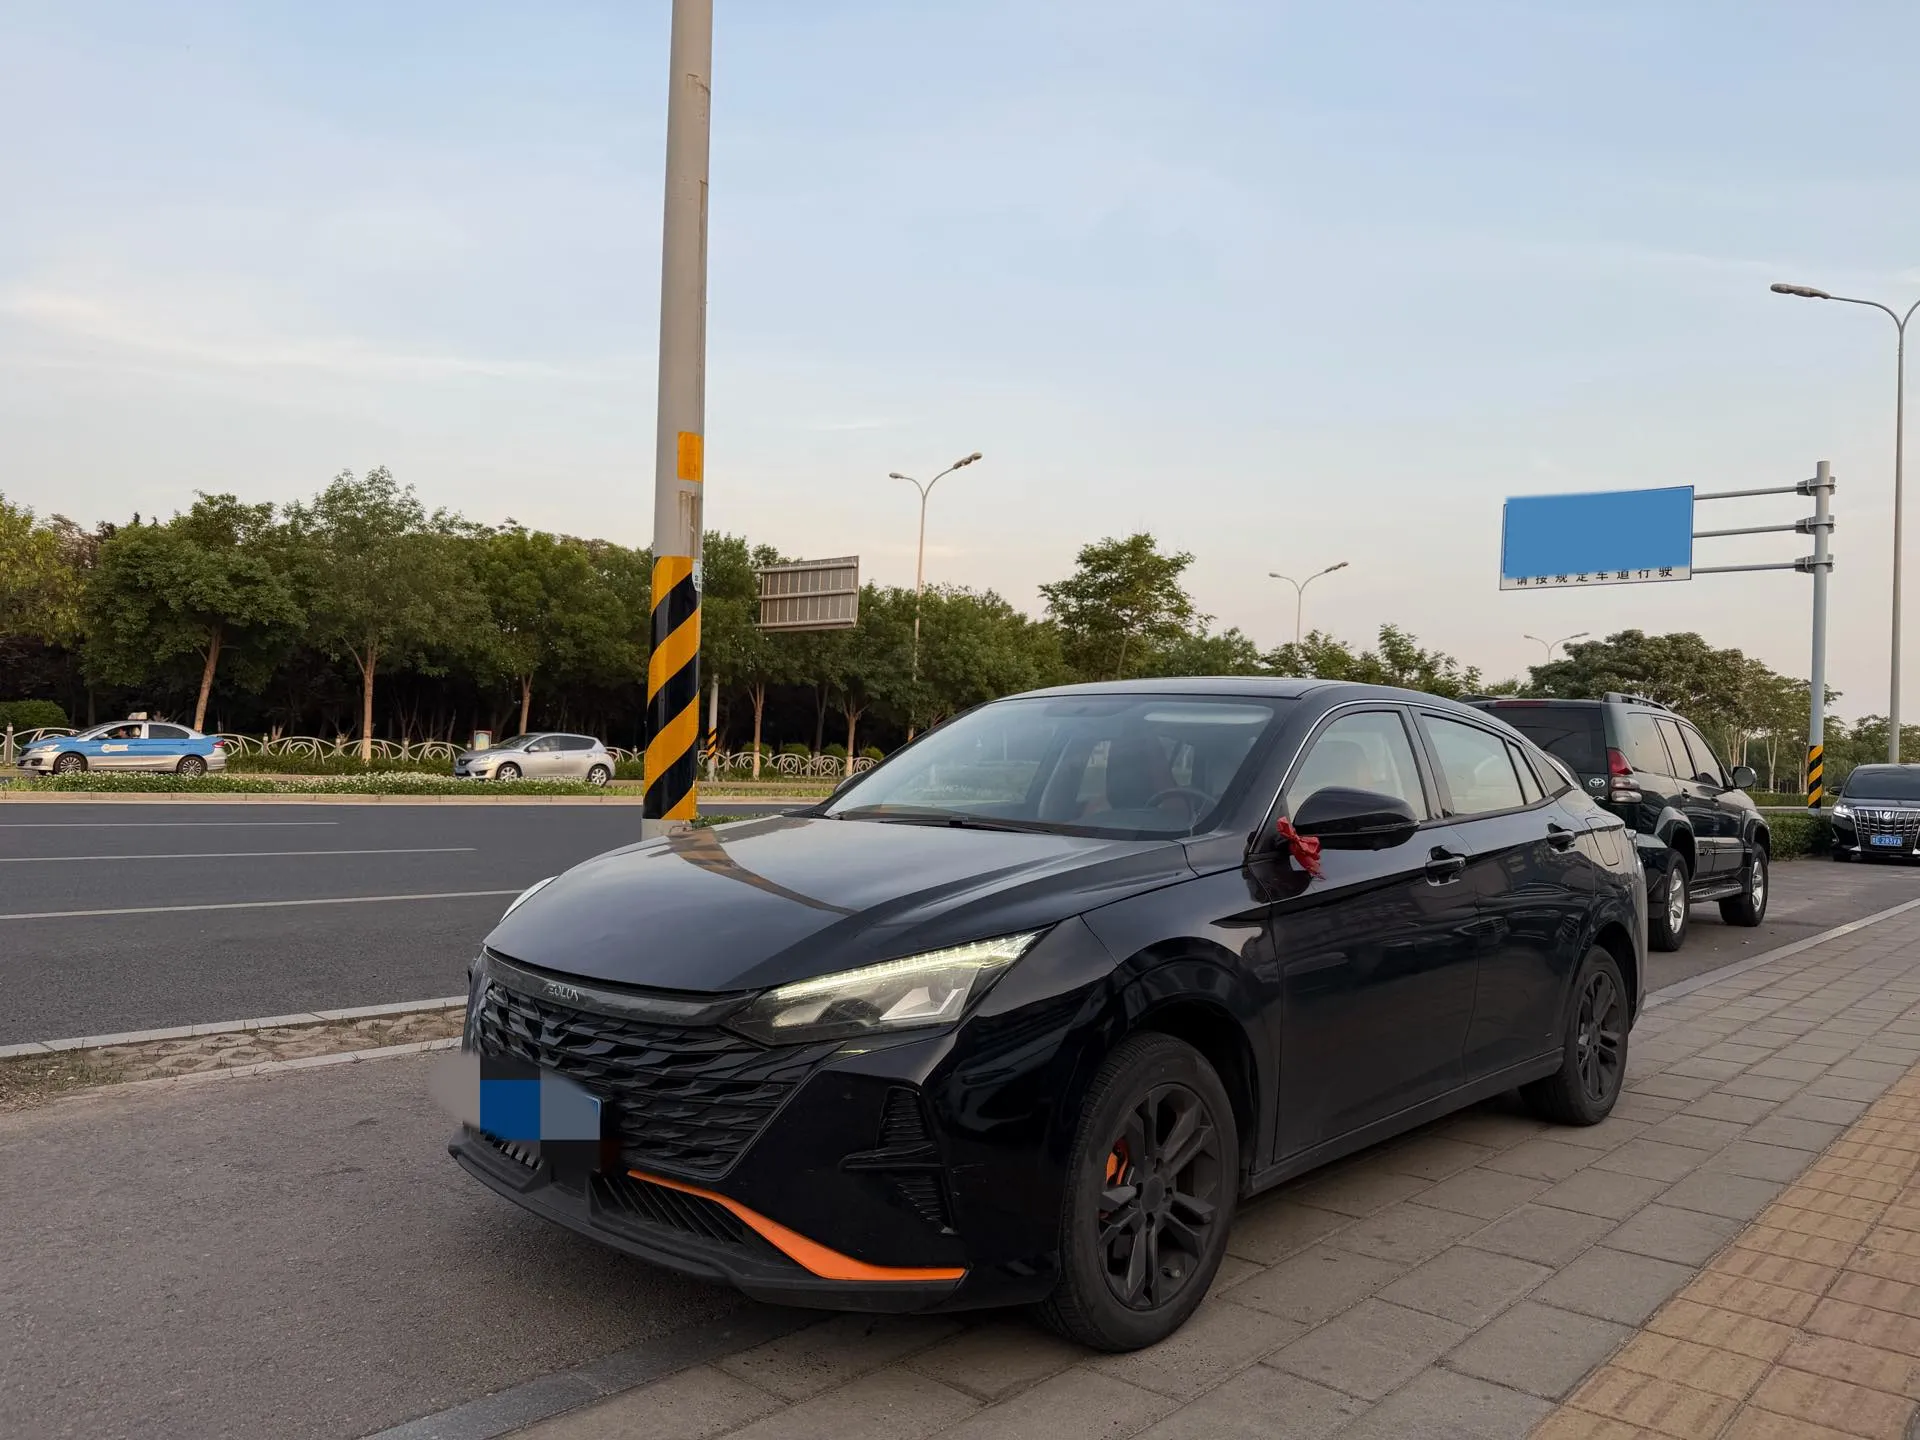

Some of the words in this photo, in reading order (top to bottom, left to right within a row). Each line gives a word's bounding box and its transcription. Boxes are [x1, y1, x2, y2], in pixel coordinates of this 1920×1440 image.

[1516, 566, 1672, 586] 请按规定车道行驶
